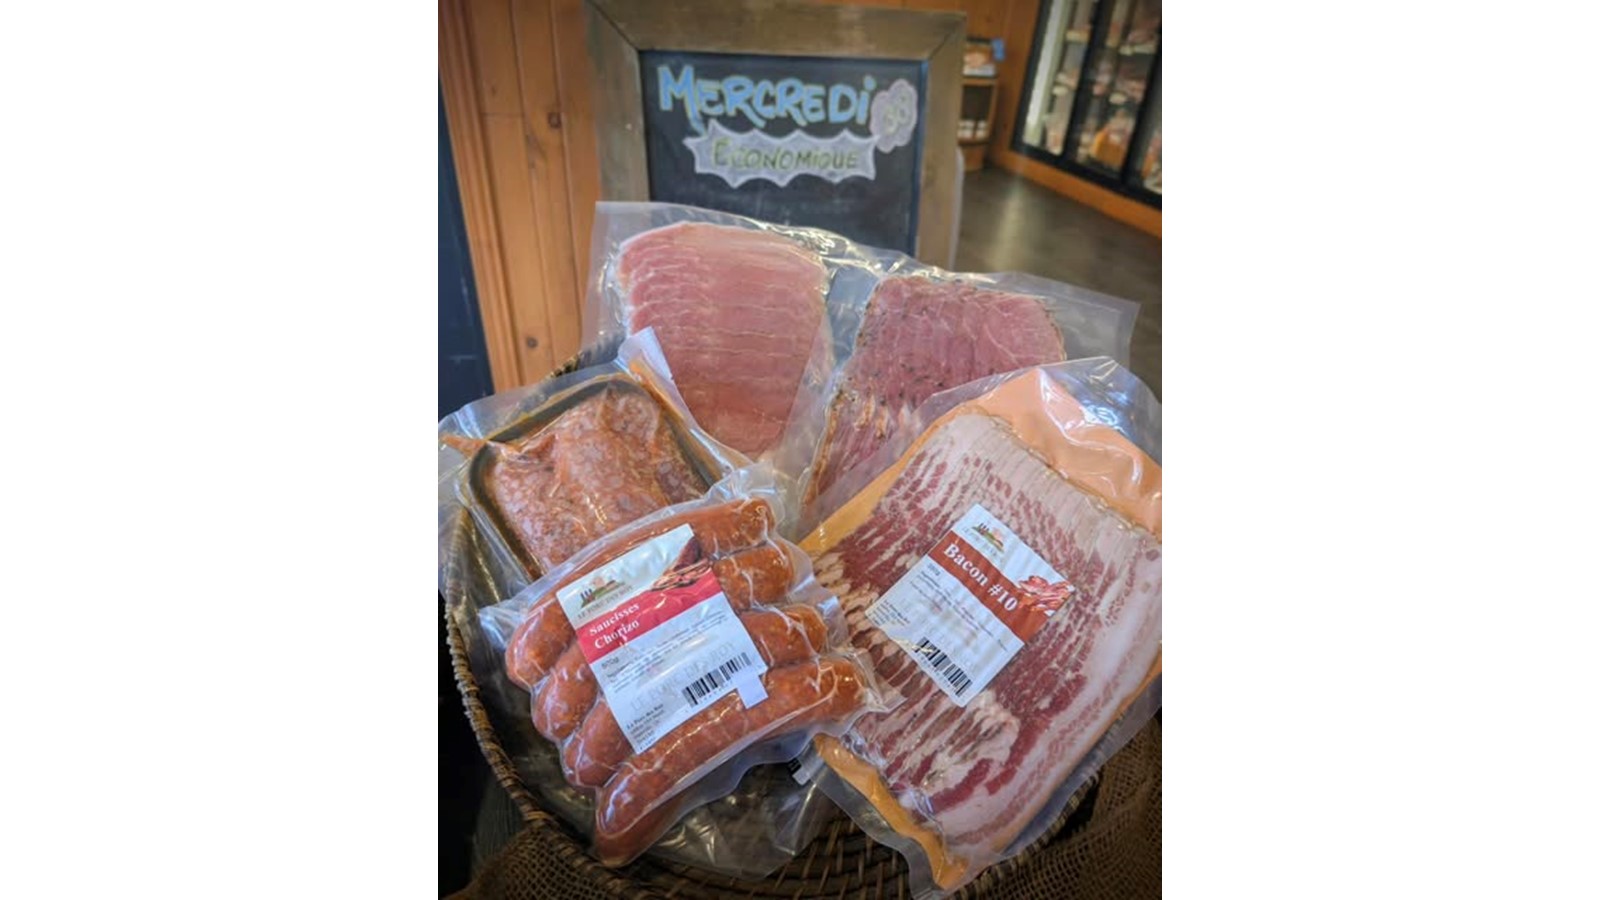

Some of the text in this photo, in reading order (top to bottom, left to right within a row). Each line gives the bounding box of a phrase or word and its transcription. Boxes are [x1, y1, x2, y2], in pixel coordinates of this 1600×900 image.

[943, 542, 989, 587] Bacon
[986, 583, 1019, 612] #10
[589, 601, 641, 637] Saucisses
[594, 618, 640, 650] Chorizo
